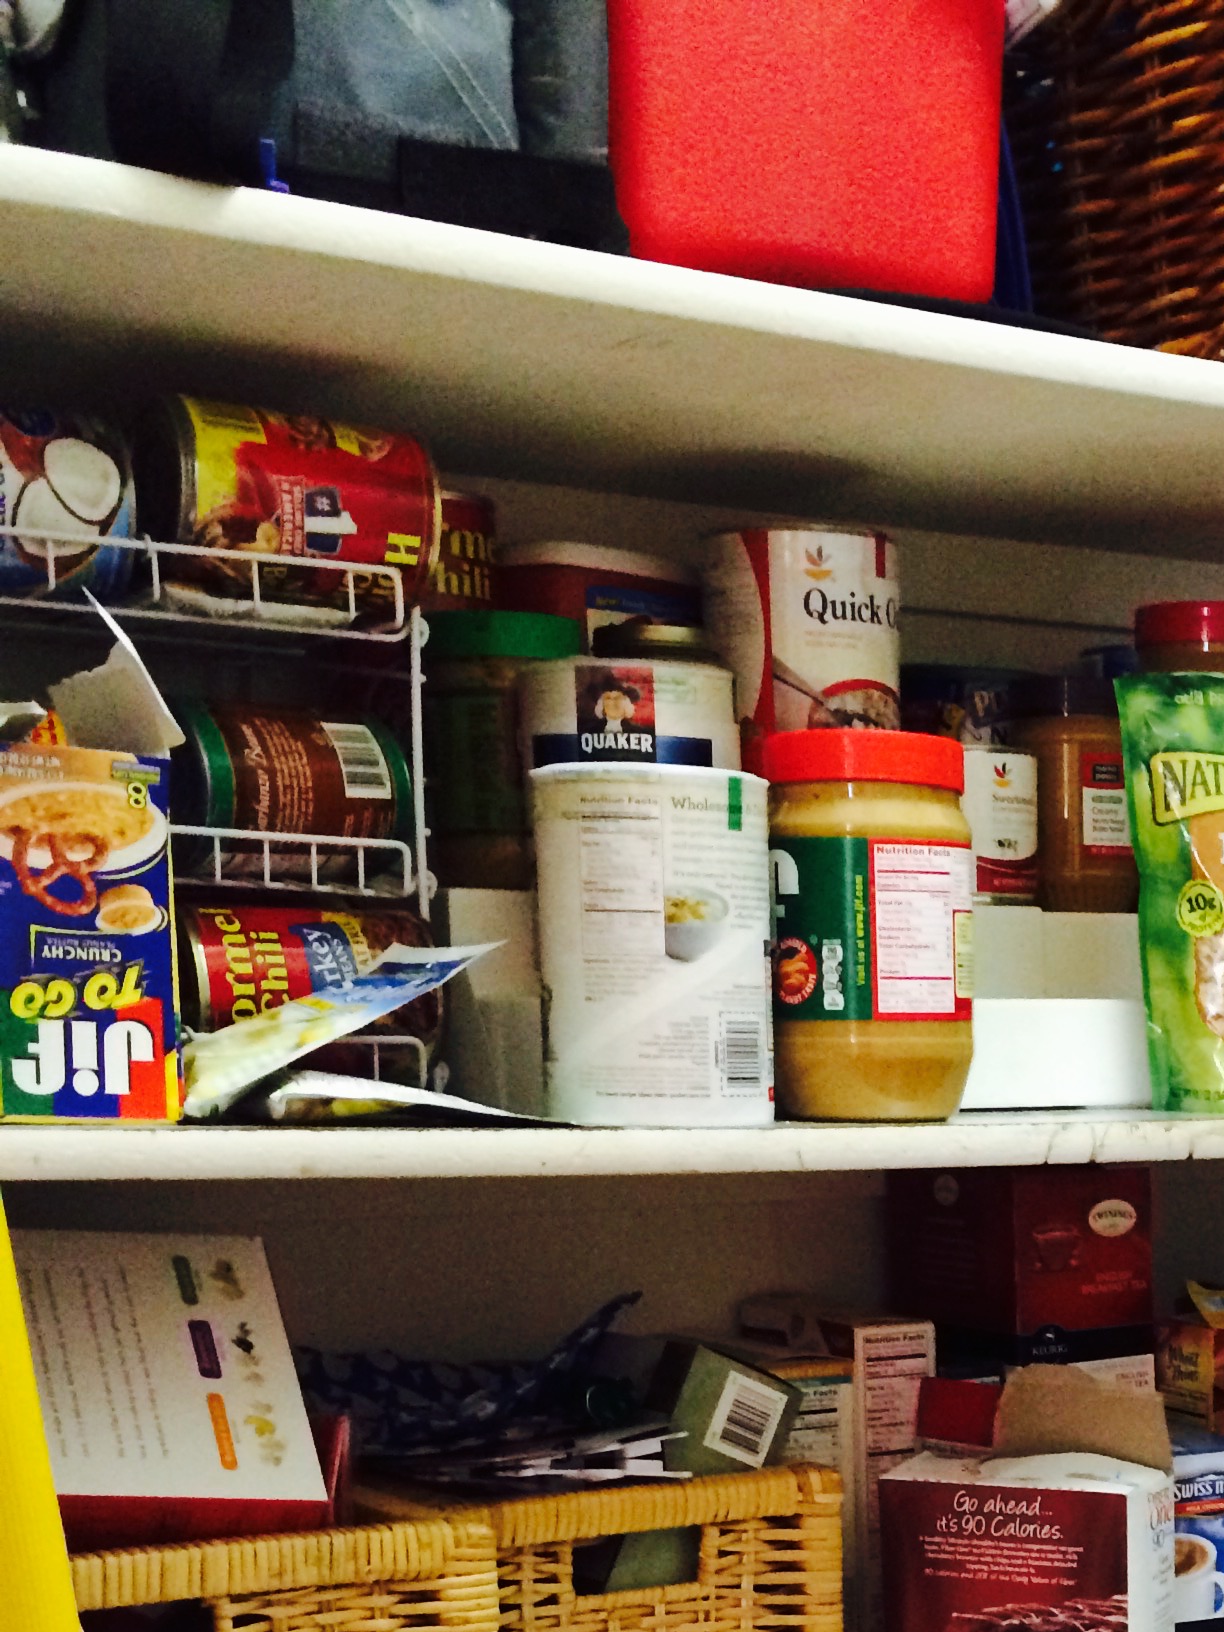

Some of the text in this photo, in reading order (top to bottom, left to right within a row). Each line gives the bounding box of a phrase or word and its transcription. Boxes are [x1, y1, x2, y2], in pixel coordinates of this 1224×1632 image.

[802, 587, 884, 625] Quick
[1174, 690, 1204, 706] add
[580, 732, 654, 753] QUAKER
[126, 781, 148, 810] 8
[876, 846, 951, 857] Nutrition Facts
[41, 944, 122, 963] CRUNCHY
[198, 908, 257, 1024] ormel
[302, 927, 343, 986] rkey
[249, 931, 291, 1015] Chili
[10, 965, 143, 1020] TO GO
[11, 1020, 155, 1097] Jif
[953, 1490, 1053, 1517] Go ahead...
[936, 1513, 1064, 1540] it's 90 Calories.
